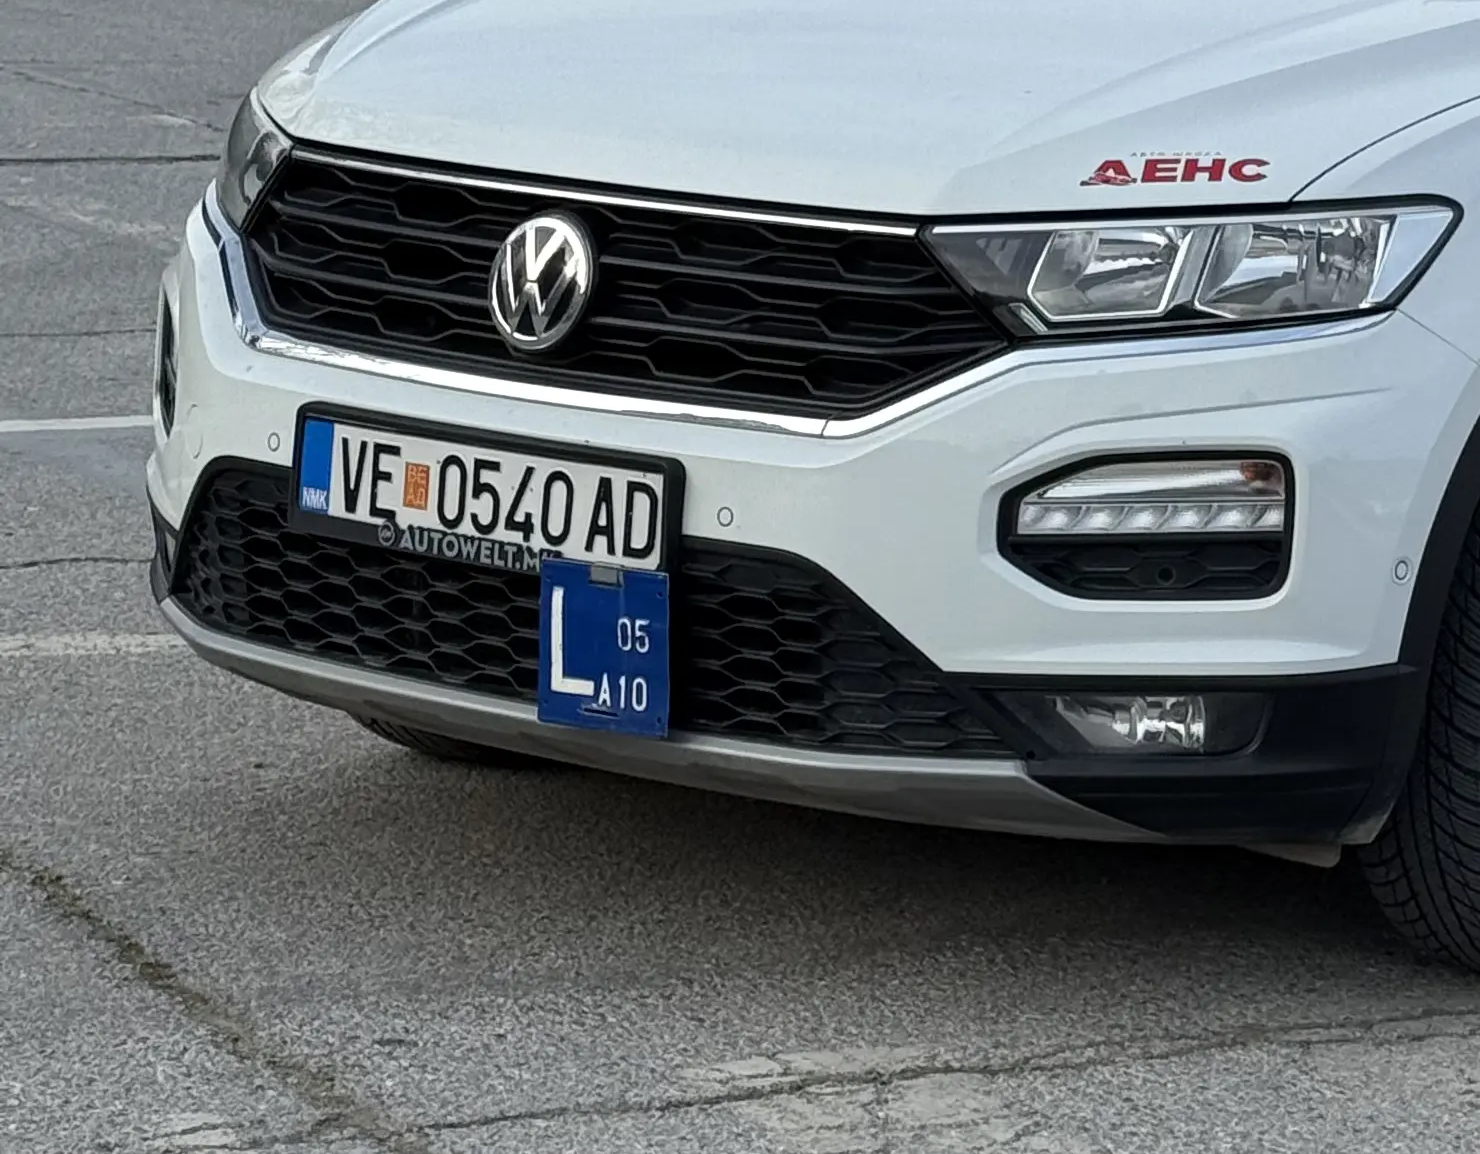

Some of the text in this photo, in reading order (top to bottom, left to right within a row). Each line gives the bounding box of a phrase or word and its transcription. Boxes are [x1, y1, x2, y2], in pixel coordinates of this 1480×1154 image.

[302, 486, 328, 511] NMK
[341, 436, 659, 560] VE 0540 AD
[400, 528, 554, 574] AUTOWELT.M
[551, 585, 595, 696] L
[617, 616, 650, 654] 05
[597, 672, 648, 712] A10
